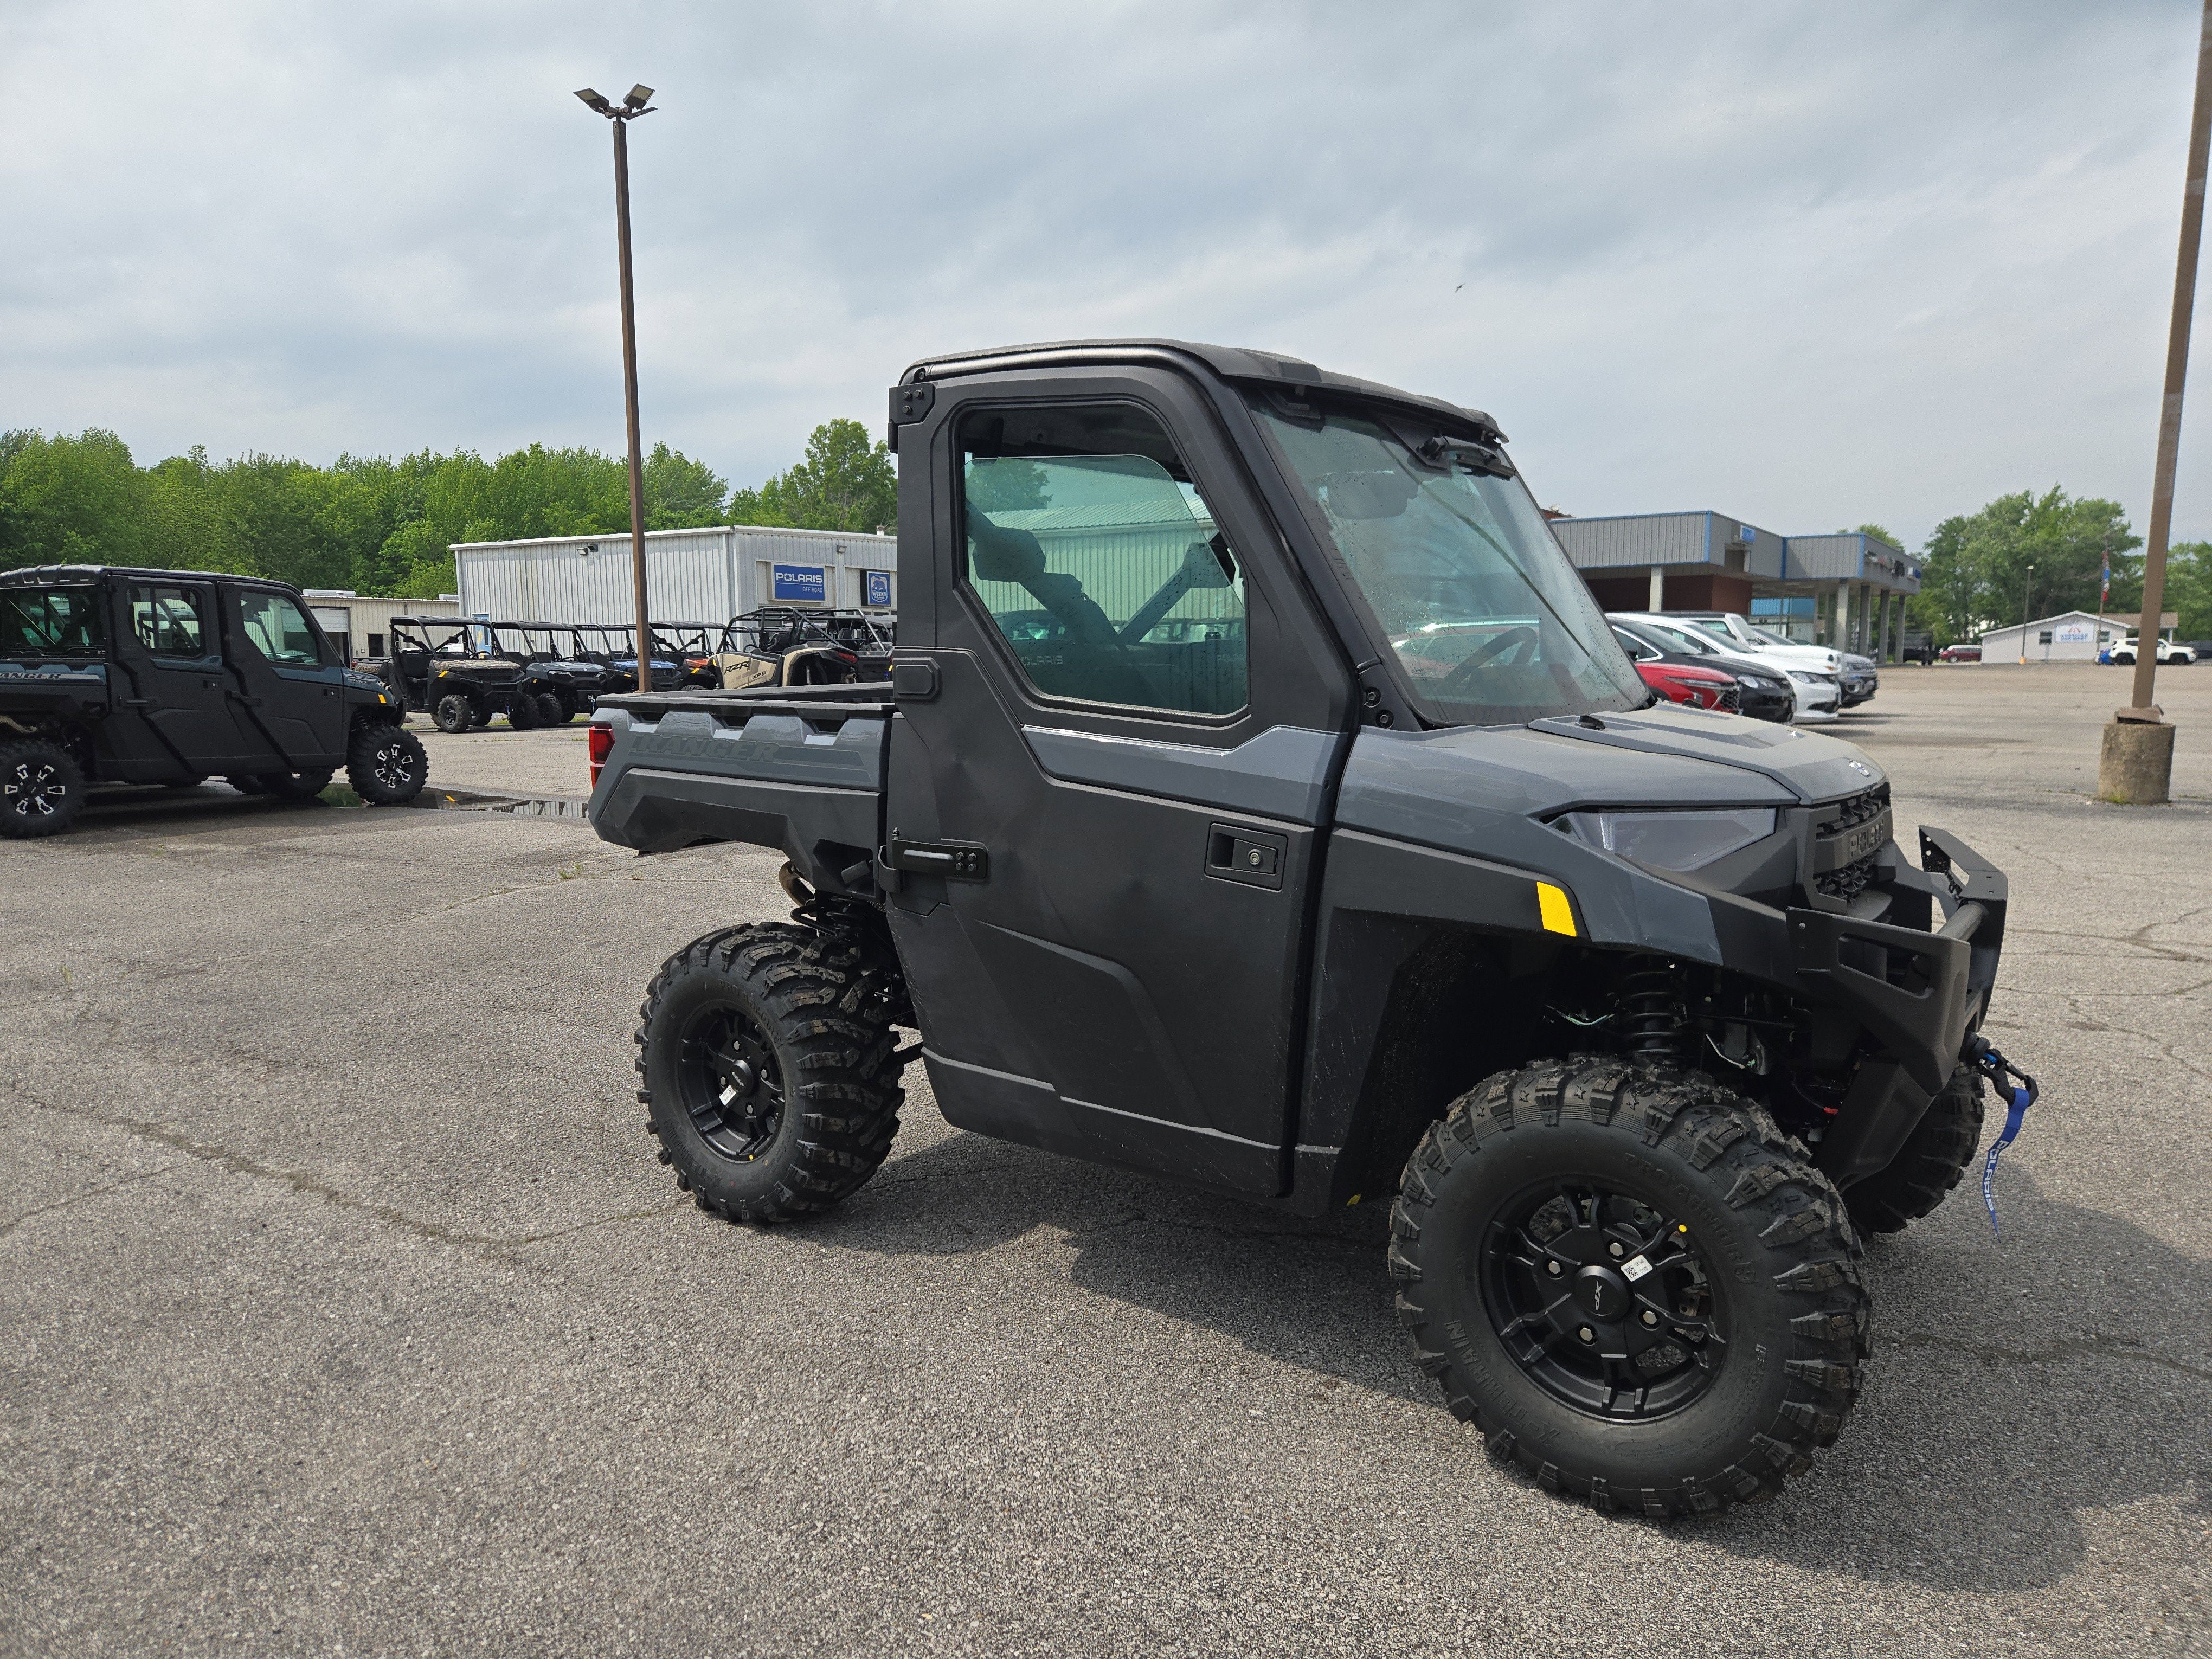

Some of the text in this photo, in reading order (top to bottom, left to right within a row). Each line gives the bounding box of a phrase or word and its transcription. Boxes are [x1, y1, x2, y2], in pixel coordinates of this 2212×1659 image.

[776, 573, 823, 583] POLARIS
[724, 660, 751, 675] RZR
[637, 734, 780, 762] RANGER
[1983, 1140, 2010, 1212] POLARIS
[1594, 1280, 1602, 1311] XP
